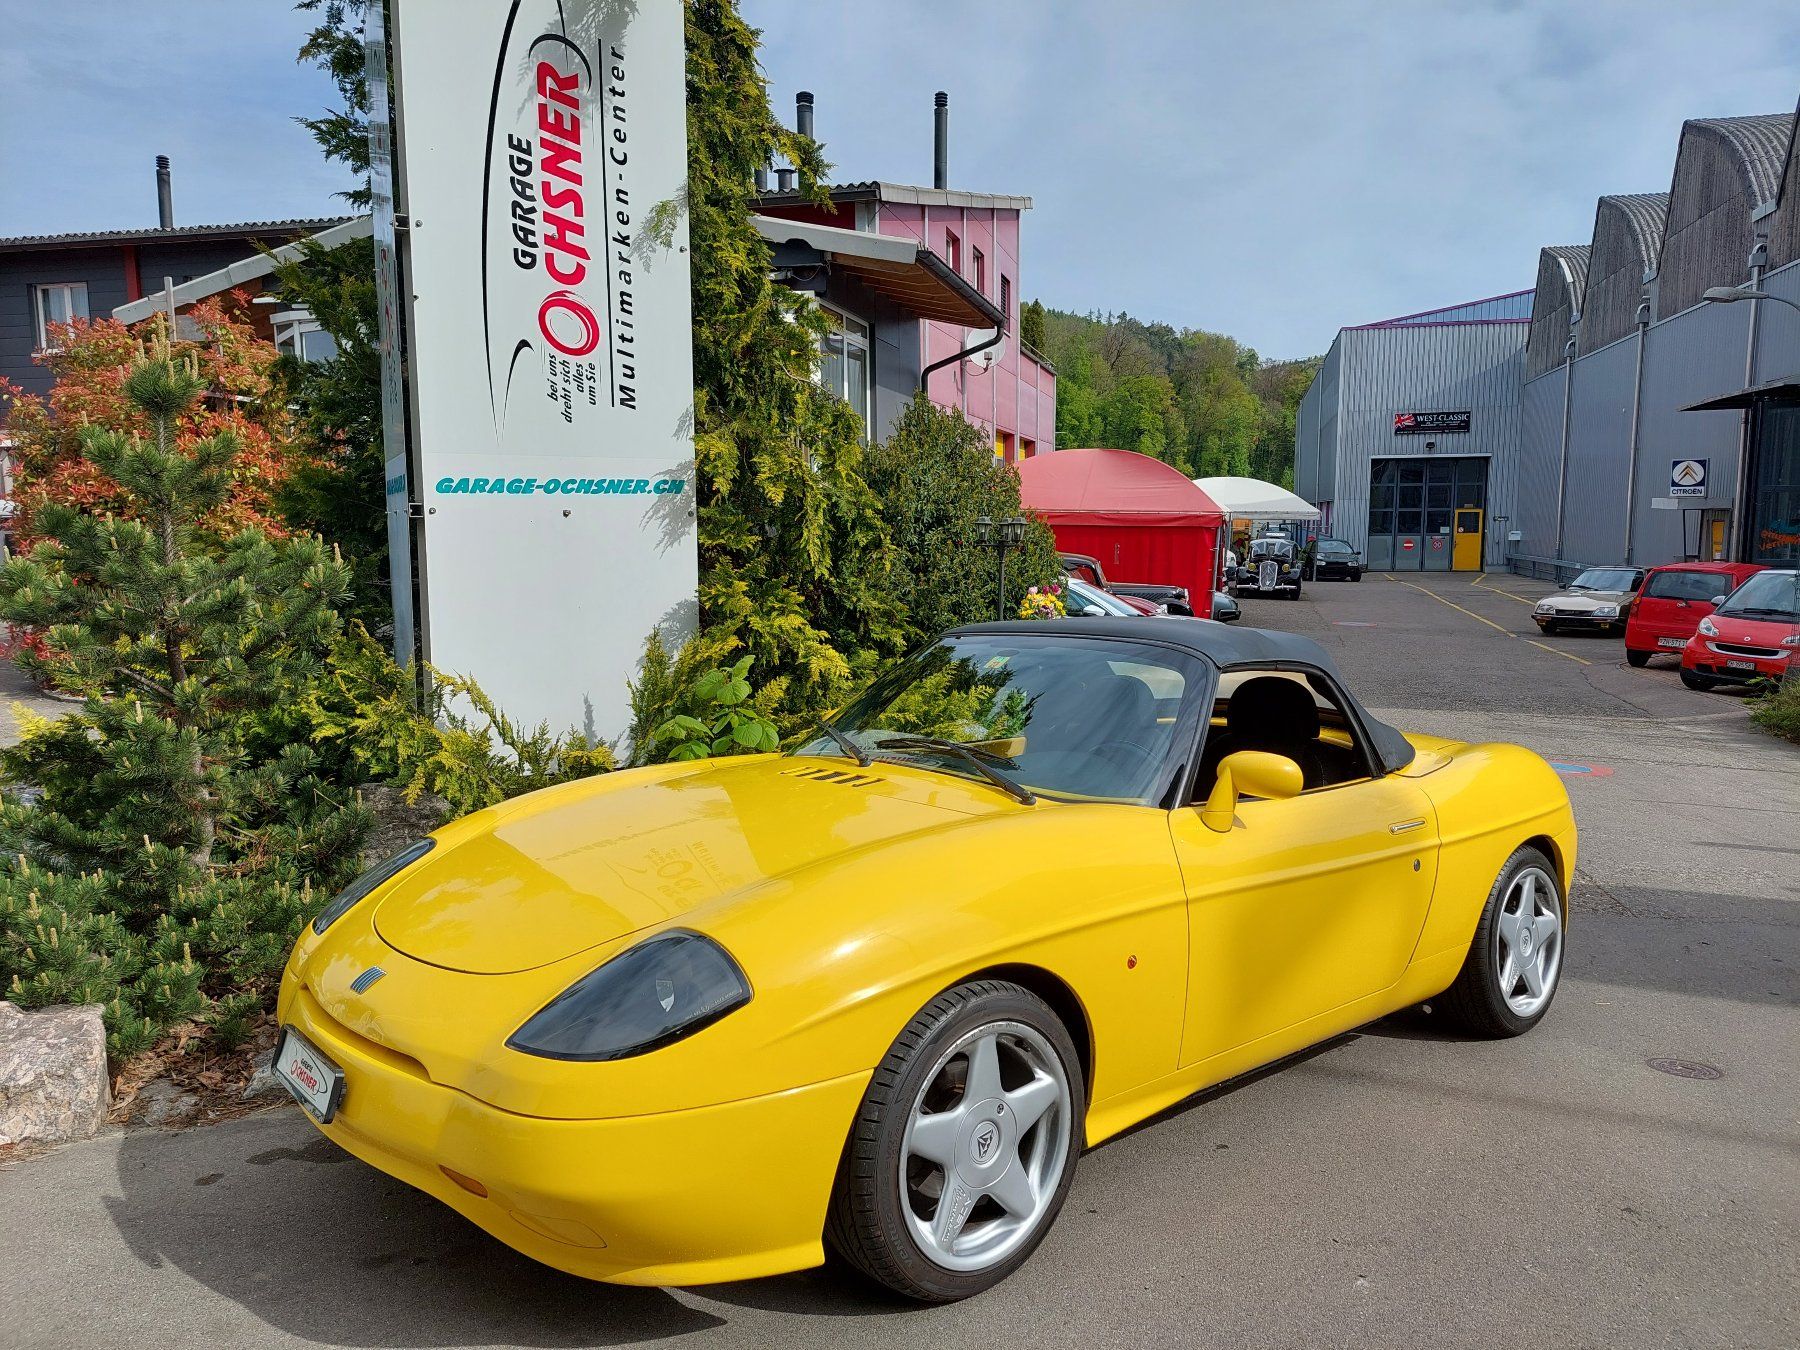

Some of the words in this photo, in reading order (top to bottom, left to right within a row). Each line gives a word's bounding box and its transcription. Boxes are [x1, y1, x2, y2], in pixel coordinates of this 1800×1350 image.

[507, 133, 539, 271] GARAGE
[535, 61, 600, 357] OCHSNER
[608, 45, 637, 411] Multimarken-Center
[548, 353, 558, 377] uns
[558, 360, 571, 386] sich
[572, 361, 584, 393] alles
[585, 362, 596, 384] Sie
[546, 378, 559, 403] bei
[588, 385, 597, 406] um
[560, 387, 573, 424] dreht
[435, 477, 686, 495] GARAGE-OCHSNER.CH
